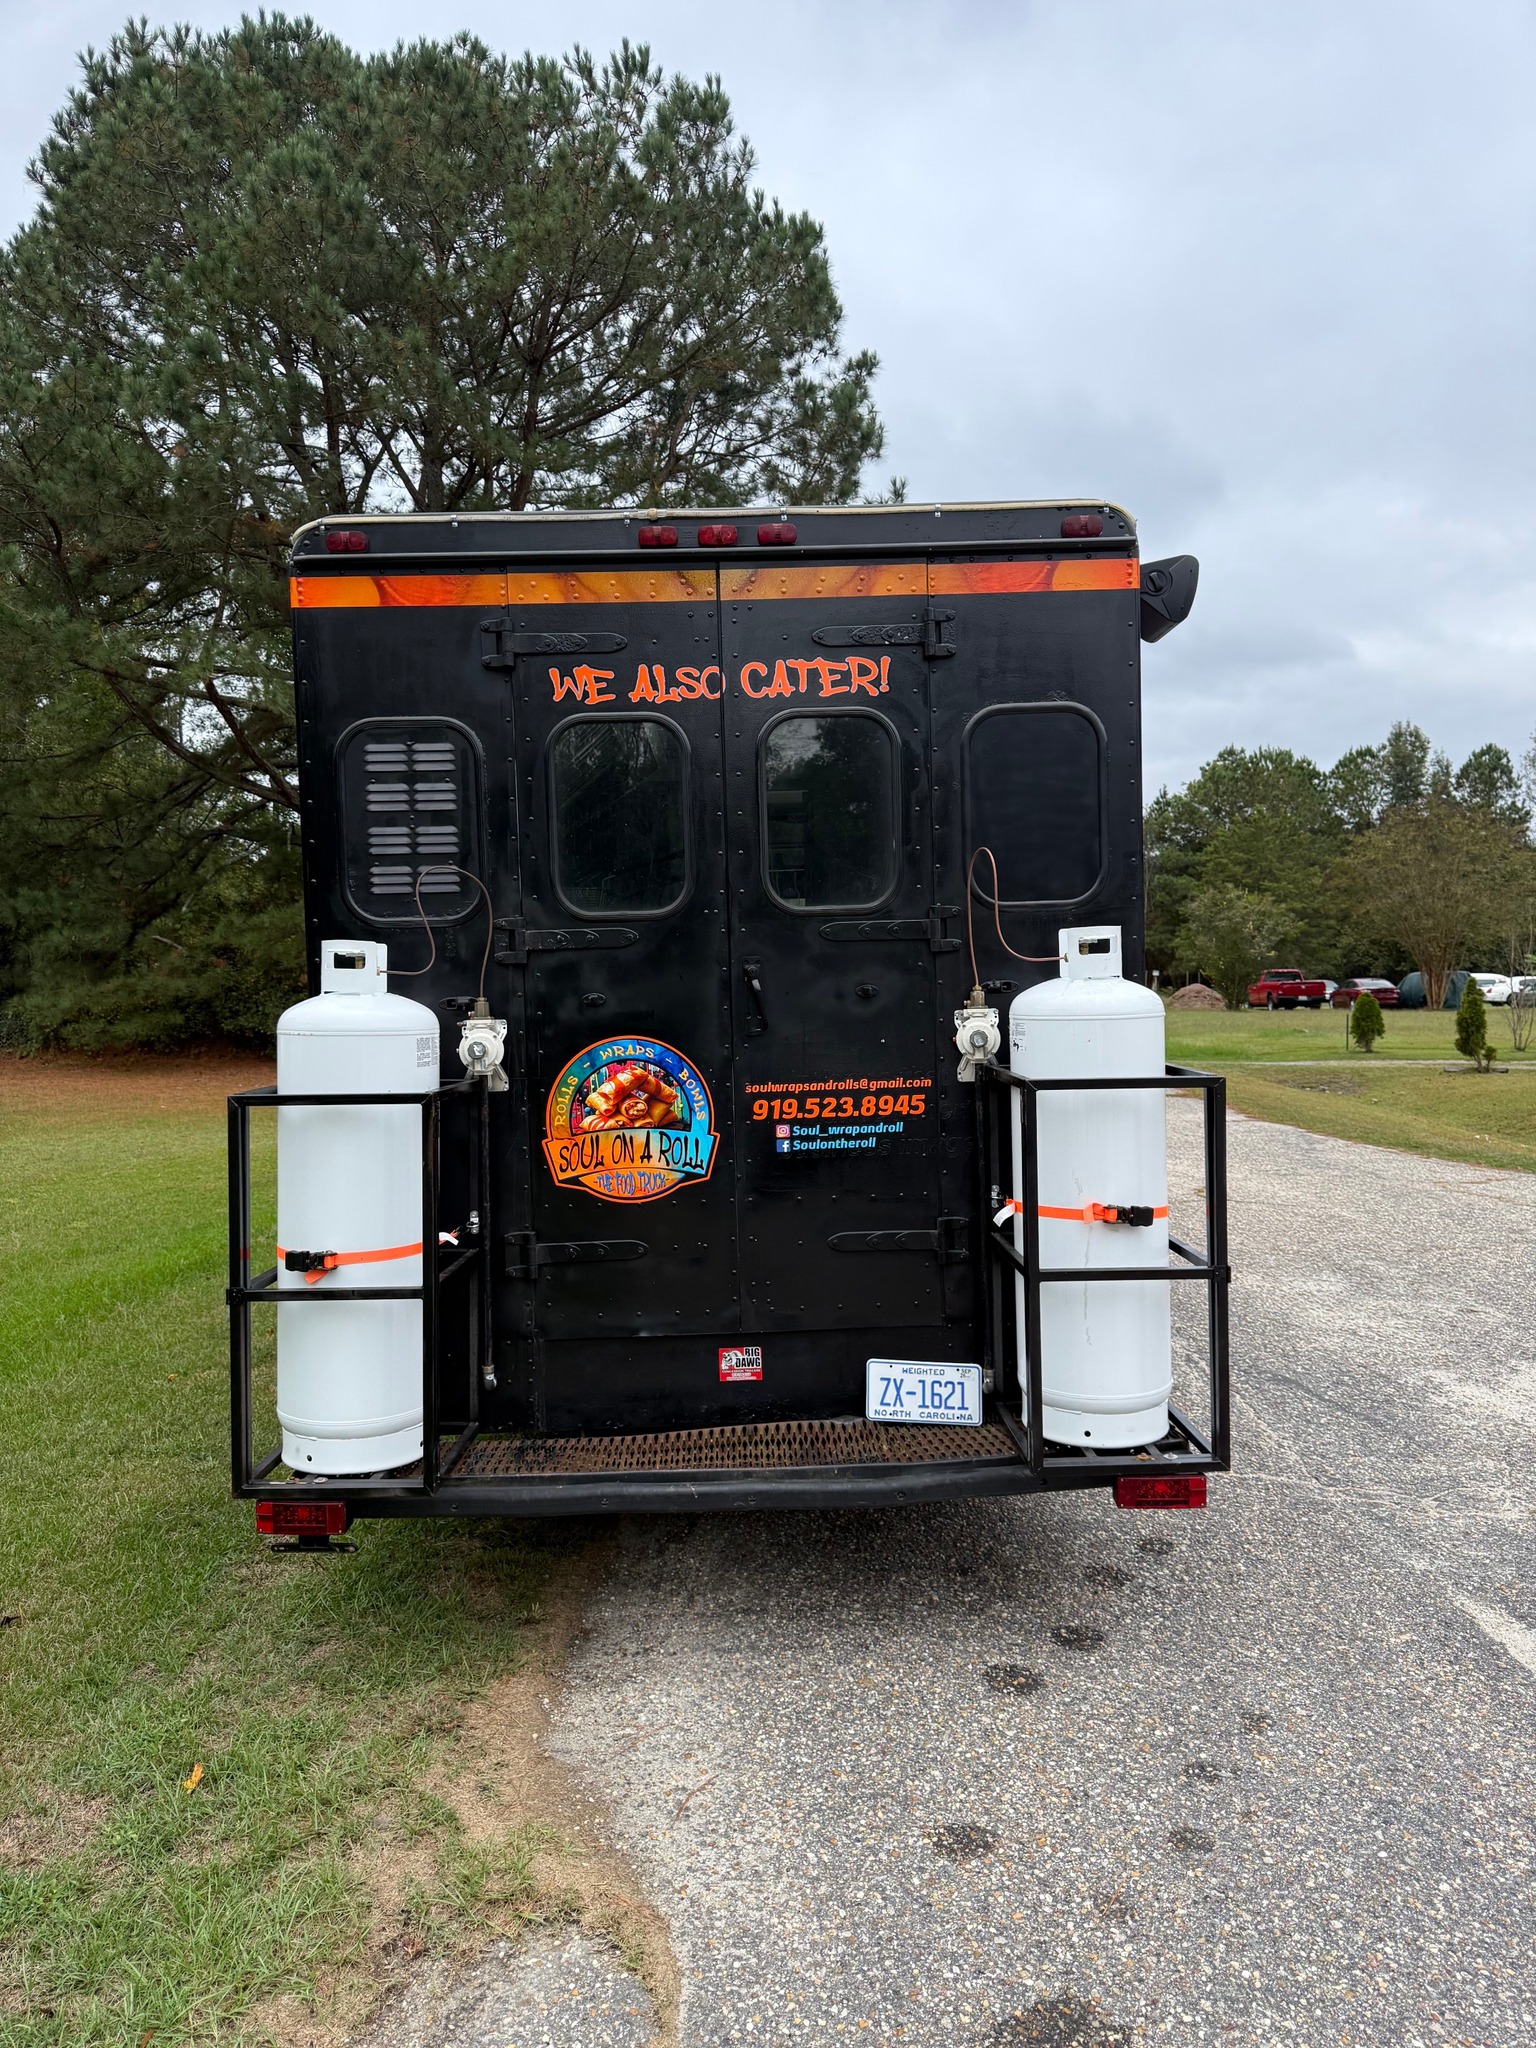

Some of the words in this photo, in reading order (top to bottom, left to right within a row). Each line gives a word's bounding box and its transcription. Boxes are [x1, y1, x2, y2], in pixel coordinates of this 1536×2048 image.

[548, 664, 616, 705] WE
[628, 664, 726, 704] ALSO
[740, 655, 891, 699] CATER!
[555, 1075, 579, 1126] ROLLS
[599, 1044, 655, 1060] WRAPS
[678, 1068, 707, 1121] BOWLS
[745, 1078, 932, 1094] soulwrapsandrolls@gmail.com
[752, 1094, 926, 1121] 919.523.8945
[792, 1122, 904, 1137] Soul_wrapandroll
[559, 1135, 605, 1173] SOUL
[612, 1132, 634, 1165] ON
[640, 1130, 652, 1164] A
[658, 1131, 704, 1171] ROLL
[793, 1137, 876, 1151] Soulontheroll
[615, 1171, 636, 1195] FOOD
[745, 1347, 760, 1357] BIG
[735, 1357, 760, 1368] DAWG
[902, 1367, 945, 1376] WEIGHTED
[879, 1377, 969, 1411] ZX-1621
[874, 1409, 911, 1418] NORTH
[919, 1411, 973, 1421] CAROLINA
